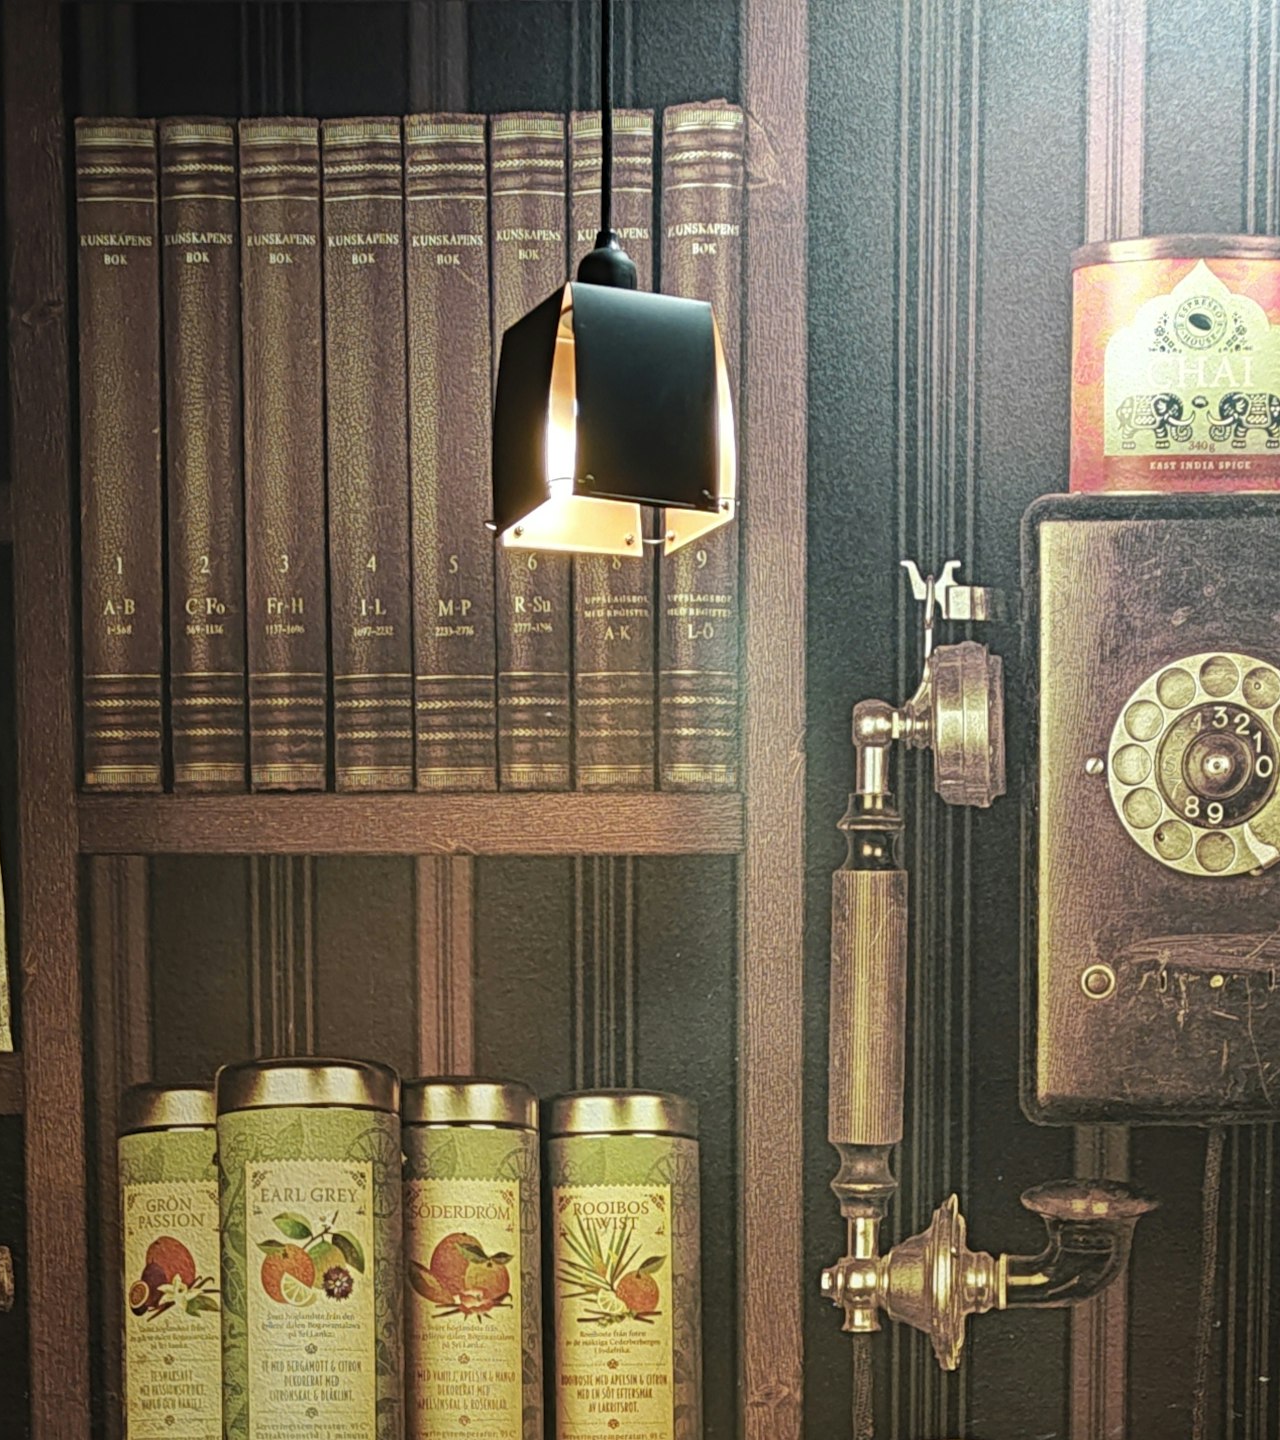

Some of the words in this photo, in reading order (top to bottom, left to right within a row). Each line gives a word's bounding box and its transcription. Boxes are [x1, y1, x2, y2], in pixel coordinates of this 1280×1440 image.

[496, 229, 562, 241] KUNSKAPENS
[667, 223, 740, 237] KUNSKAPENS
[80, 235, 152, 246] KUNSKAPENS
[164, 232, 233, 244] KUNSKAPENS
[247, 234, 316, 246] KUNSKAPENS
[328, 233, 399, 247] KUNSKAPENS
[412, 234, 483, 247] KUNSKAPENS
[518, 249, 540, 260] BOK
[692, 243, 716, 255] BOK
[104, 254, 128, 265] BOK
[186, 252, 209, 263] BOK
[269, 253, 293, 264] BOK
[351, 253, 375, 264] BOK
[436, 254, 460, 266] BOK
[1178, 299, 1223, 320] ESPRESSO
[1183, 334, 1218, 348] HOUSE
[1146, 355, 1254, 388] CHAI
[1150, 461, 1176, 470] EAST
[1180, 461, 1214, 470] INDIA
[1218, 461, 1252, 469] SPICE
[115, 557, 123, 575] 1
[200, 556, 210, 574] 2
[280, 555, 289, 573] 3
[366, 555, 377, 573] 4
[449, 555, 458, 575] 5
[527, 551, 537, 570] 6
[697, 551, 707, 569] 9
[438, 600, 472, 617] M-P
[604, 627, 631, 641] A-K
[1212, 706, 1228, 728] 3
[1233, 713, 1250, 735] 2
[1253, 731, 1262, 753] 1
[1255, 755, 1273, 777] 0
[1185, 795, 1199, 817] 8
[1207, 802, 1224, 824] 9
[260, 1187, 305, 1203] EARL
[310, 1187, 358, 1203] GREY
[145, 1196, 192, 1213] GRÖN
[411, 1202, 510, 1220] SÖDERDRÖM
[572, 1201, 649, 1215] ROOIBOS
[138, 1213, 205, 1229] PASSION
[583, 1216, 640, 1230] TWIST
[287, 1360, 328, 1372] BERGAMOTT
[338, 1360, 362, 1372] CITRON
[284, 1375, 323, 1387] DEKORERAT
[325, 1375, 339, 1386] MED
[595, 1375, 608, 1385] MED
[611, 1375, 637, 1385] APELSIN
[646, 1375, 667, 1385] CITRON
[577, 1389, 589, 1399] MED
